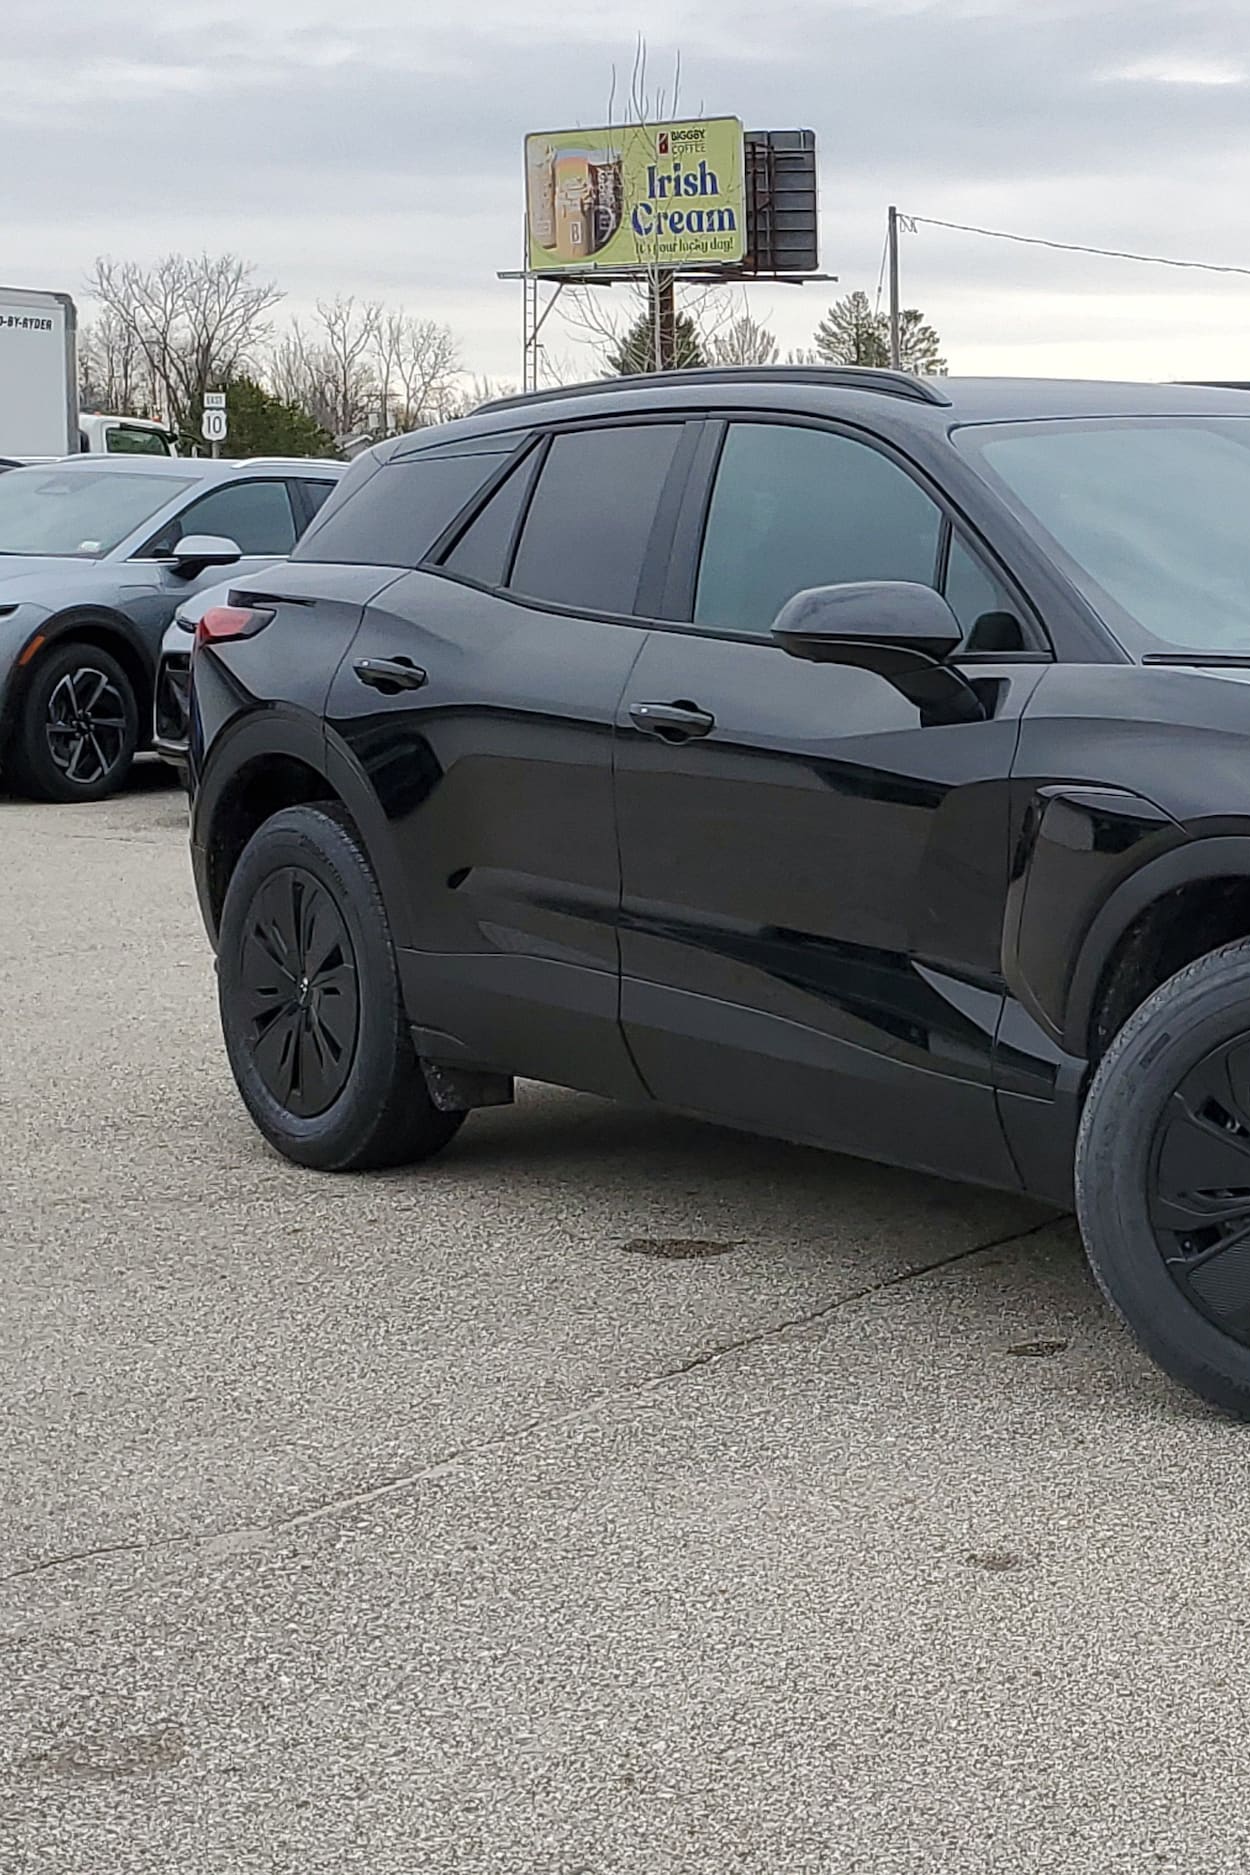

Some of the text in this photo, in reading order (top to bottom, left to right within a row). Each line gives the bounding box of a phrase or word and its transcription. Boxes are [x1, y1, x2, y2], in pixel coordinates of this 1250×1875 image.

[672, 143, 706, 154] COFFEE
[647, 160, 719, 199] Irish
[632, 202, 737, 236] Cream
[206, 416, 222, 434] 10
